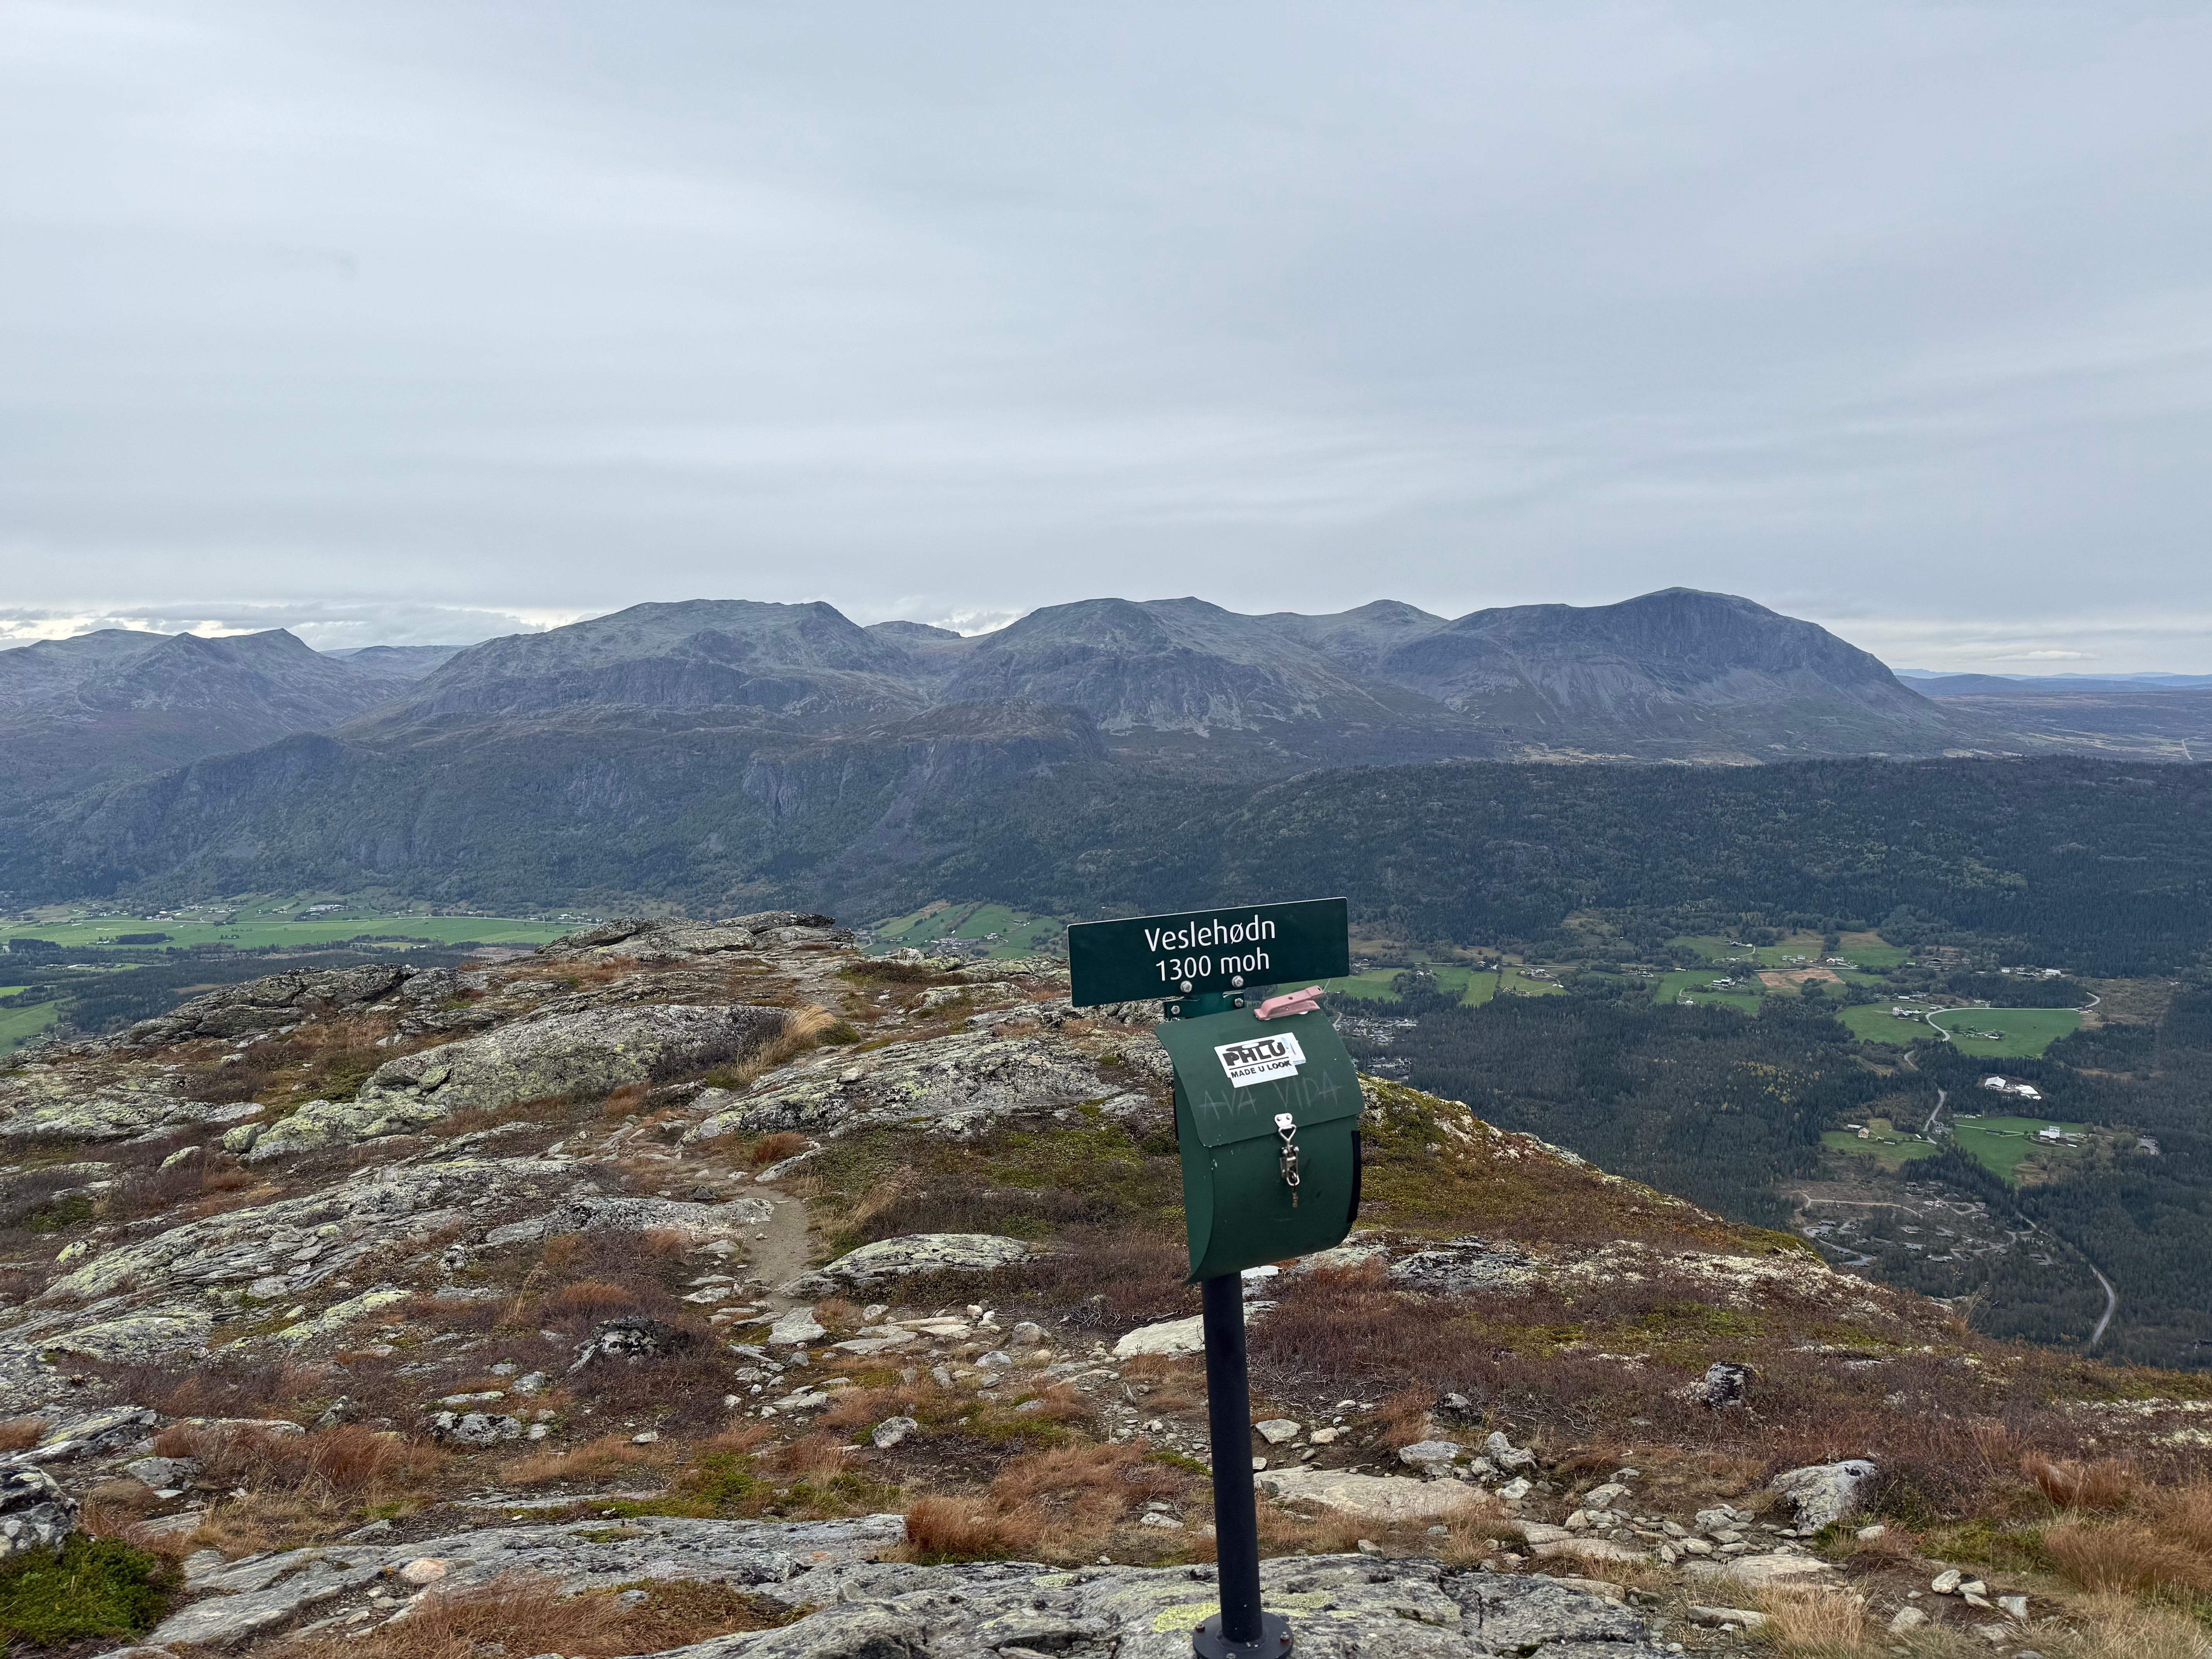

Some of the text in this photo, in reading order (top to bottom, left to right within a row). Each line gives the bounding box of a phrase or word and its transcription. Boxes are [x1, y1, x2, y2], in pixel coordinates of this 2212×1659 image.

[1144, 914, 1275, 952] Veslehødn
[1156, 947, 1269, 981] 1300 moh
[1231, 1067, 1256, 1079] MADE
[1267, 1060, 1292, 1070] LOOK
[1199, 1069, 1343, 1121] AVA VIDA
